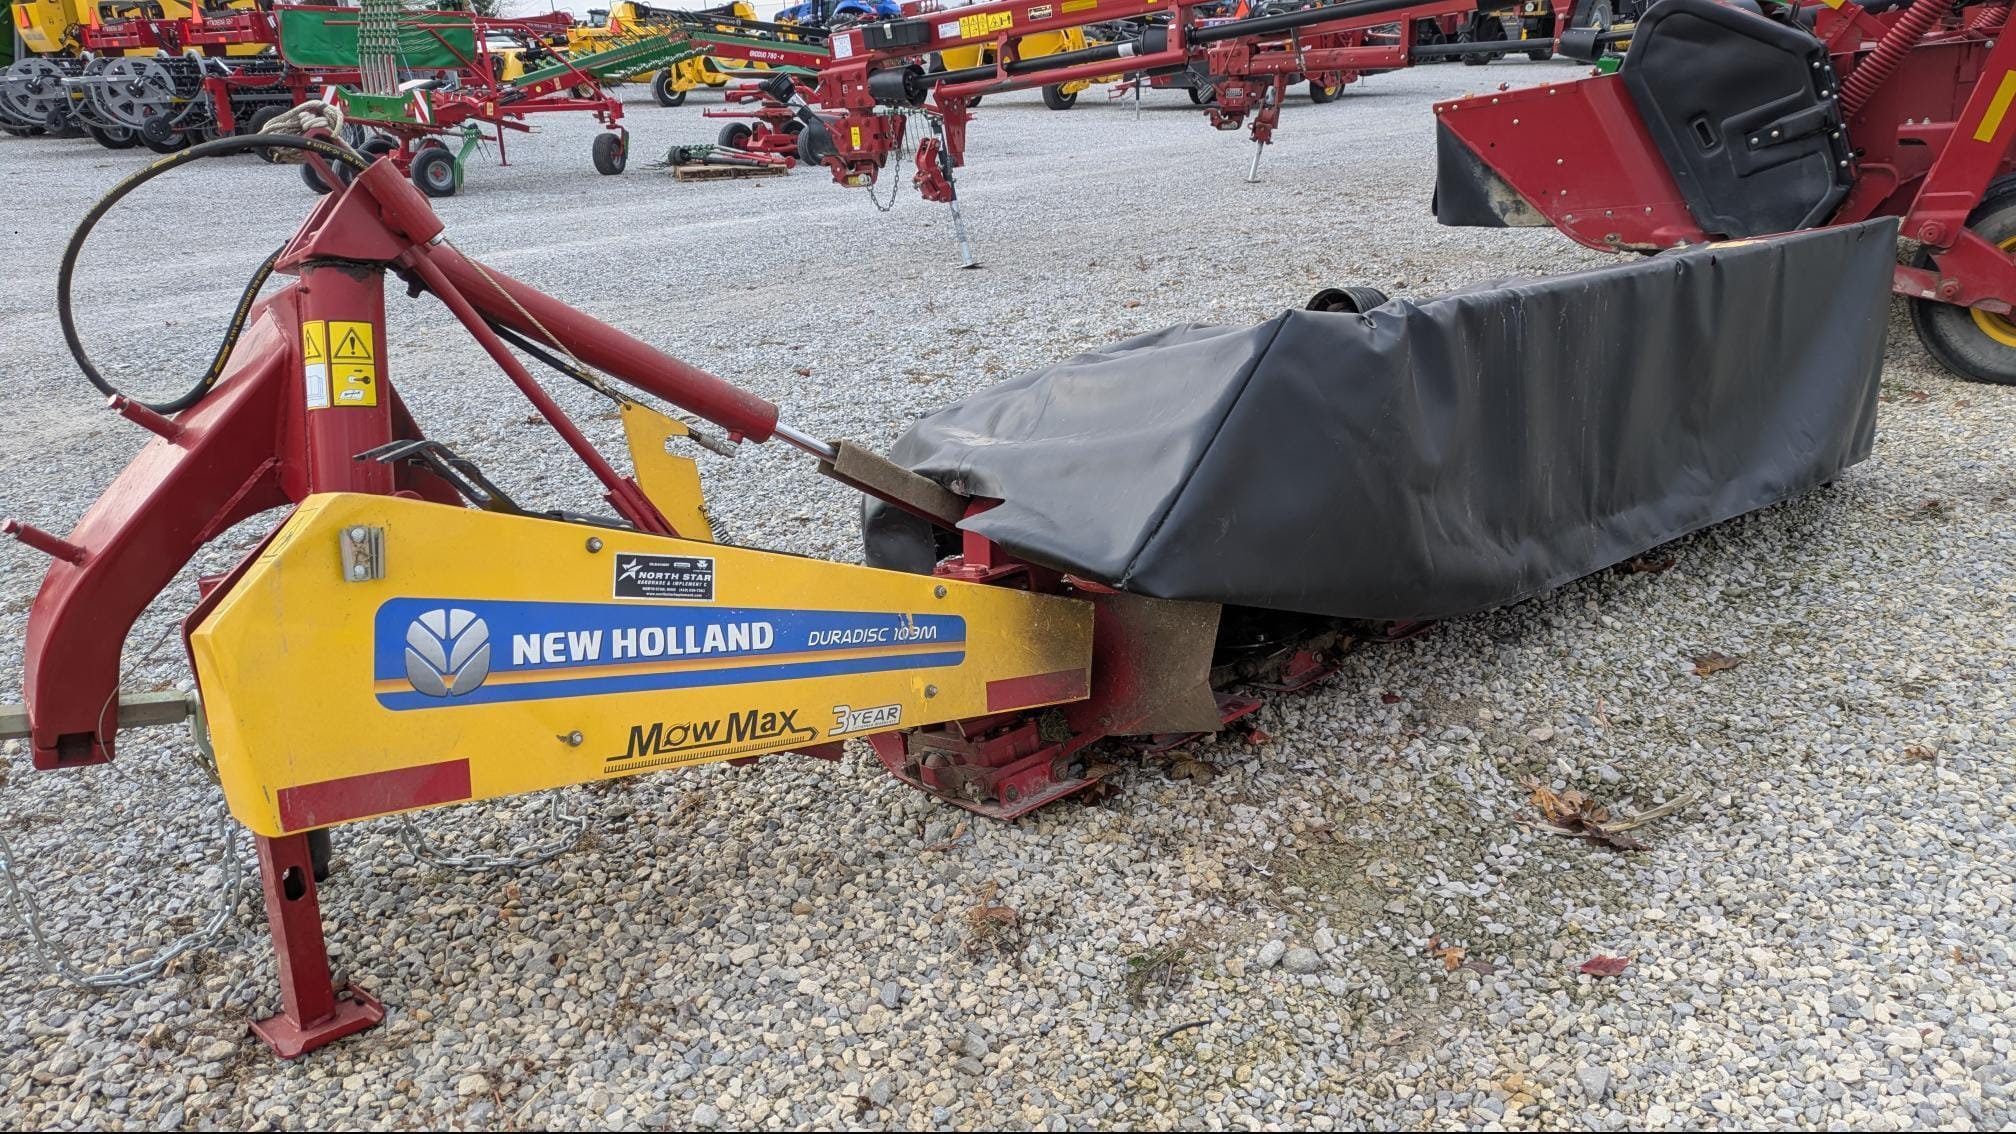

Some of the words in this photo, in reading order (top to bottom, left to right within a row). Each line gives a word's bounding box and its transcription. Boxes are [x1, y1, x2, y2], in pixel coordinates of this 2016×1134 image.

[638, 572, 680, 580] NORTH
[683, 574, 712, 582] STAR
[513, 629, 603, 666] NEW
[612, 620, 775, 660] HOLLAND
[807, 627, 890, 647] DURADISC
[828, 704, 852, 738] 3
[851, 707, 899, 726] YEAR
